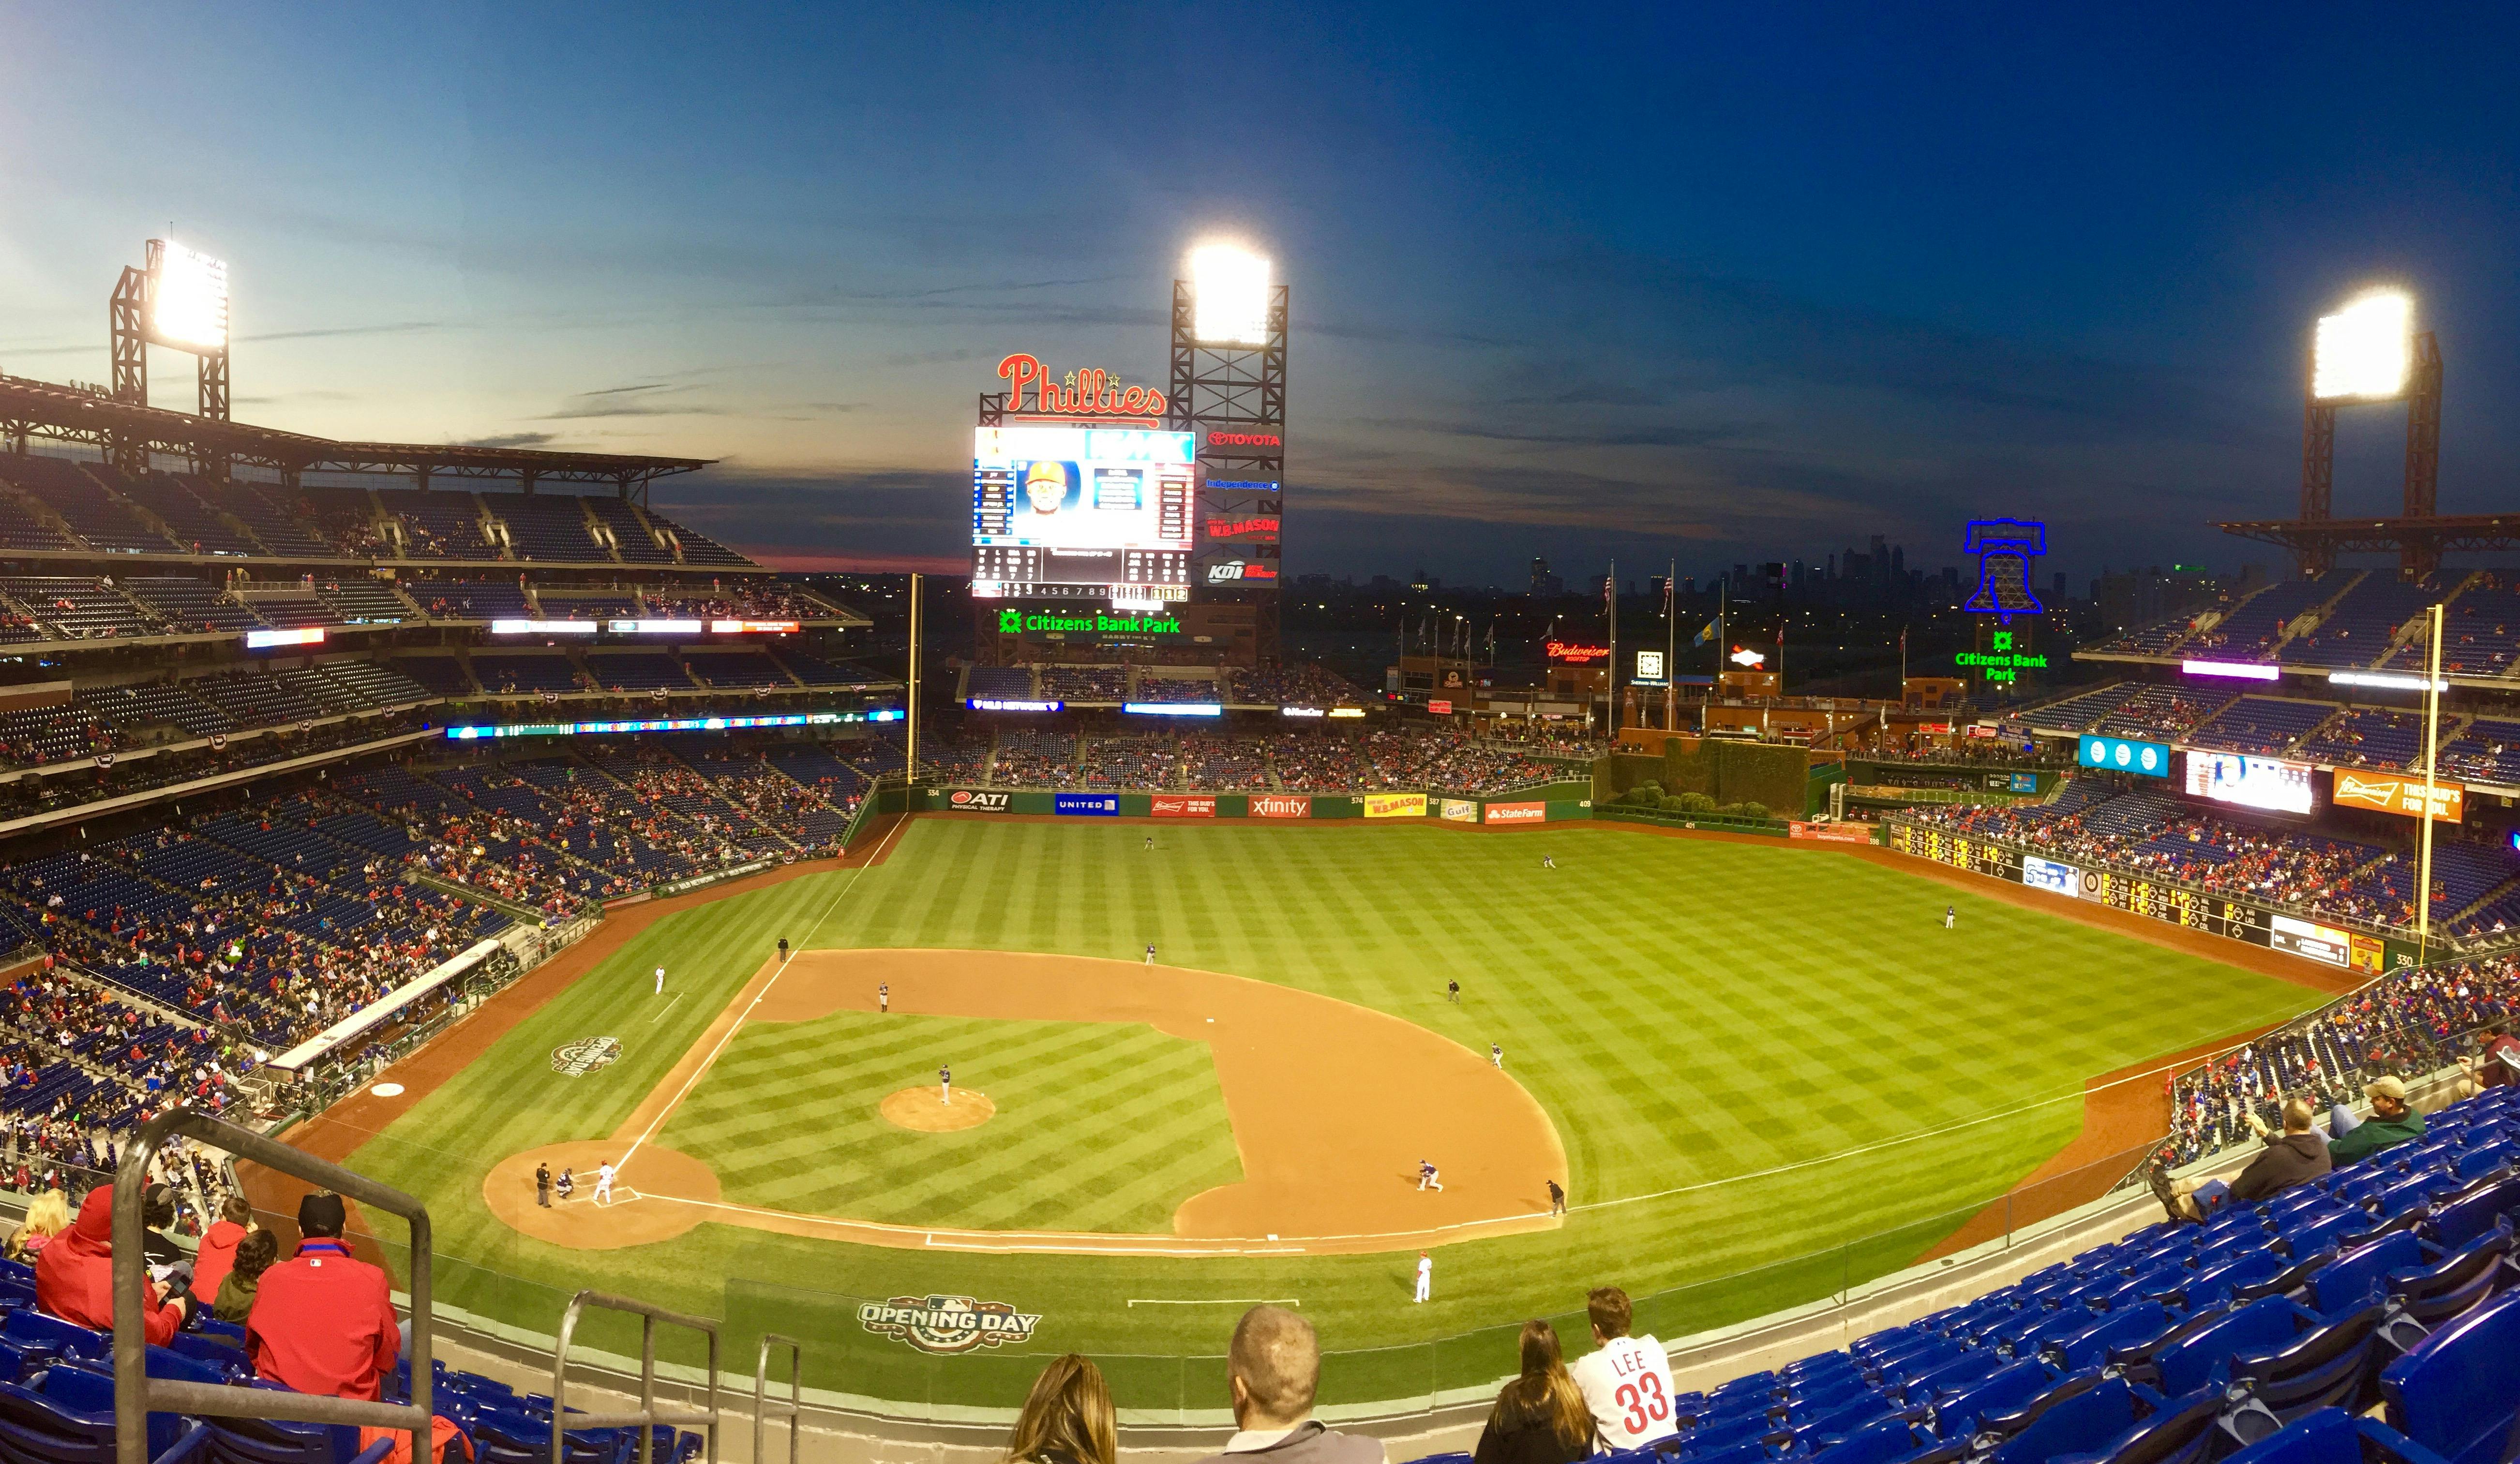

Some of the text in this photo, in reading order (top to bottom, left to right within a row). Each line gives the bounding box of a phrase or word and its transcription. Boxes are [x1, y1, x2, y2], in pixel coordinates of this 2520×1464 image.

[998, 353, 1167, 415] Phillies
[1227, 434, 1280, 446] TOYOTA
[1206, 478, 1268, 490] Independence
[1154, 589, 1185, 600] 1 1 2
[1026, 615, 1180, 633] Citizens Bank Park
[1547, 642, 1610, 657] Budweiser
[1955, 653, 2047, 668] Citizens Bank
[1986, 668, 2016, 681] Park
[640, 721, 665, 730] CAVITY
[2341, 780, 2391, 798] Budweiser
[2403, 783, 2460, 803] THIS UD'S
[970, 793, 1008, 806] ATI
[1253, 797, 1306, 816] xfinity
[2403, 798, 2423, 811] FOR
[1447, 805, 1470, 816] Gulf
[2397, 954, 2413, 967] 330
[562, 1037, 616, 1076] OPENING DAY
[861, 1306, 1036, 1332] OPENING DAY
[1612, 1351, 1646, 1377] LEE
[1615, 1372, 1669, 1435] 33
